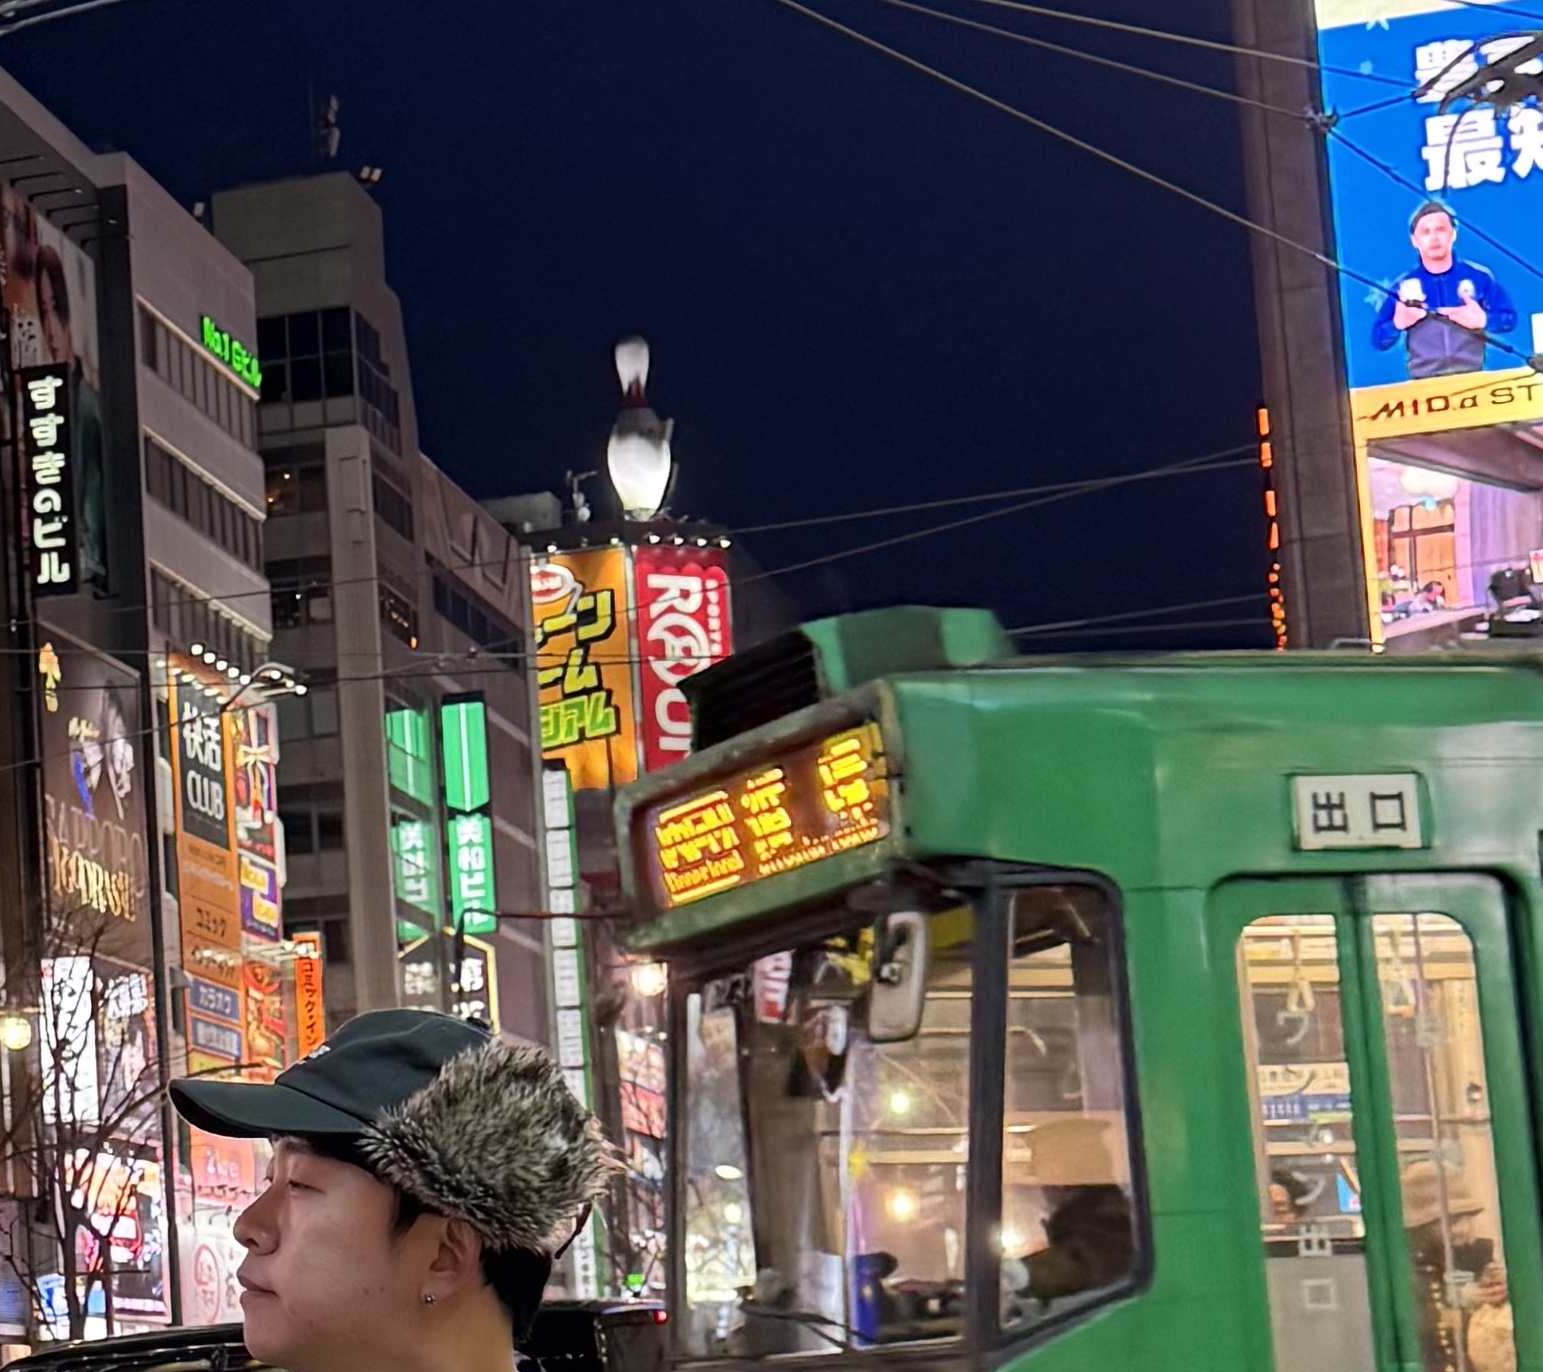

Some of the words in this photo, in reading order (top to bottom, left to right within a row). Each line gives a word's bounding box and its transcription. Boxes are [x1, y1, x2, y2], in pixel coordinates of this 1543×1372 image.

[27, 375, 71, 585] すすきのビル
[535, 588, 615, 646] ーン
[183, 702, 223, 772] 快活
[187, 770, 225, 821] CLUB
[1312, 790, 1408, 834] 出口
[196, 907, 227, 939] コミック
